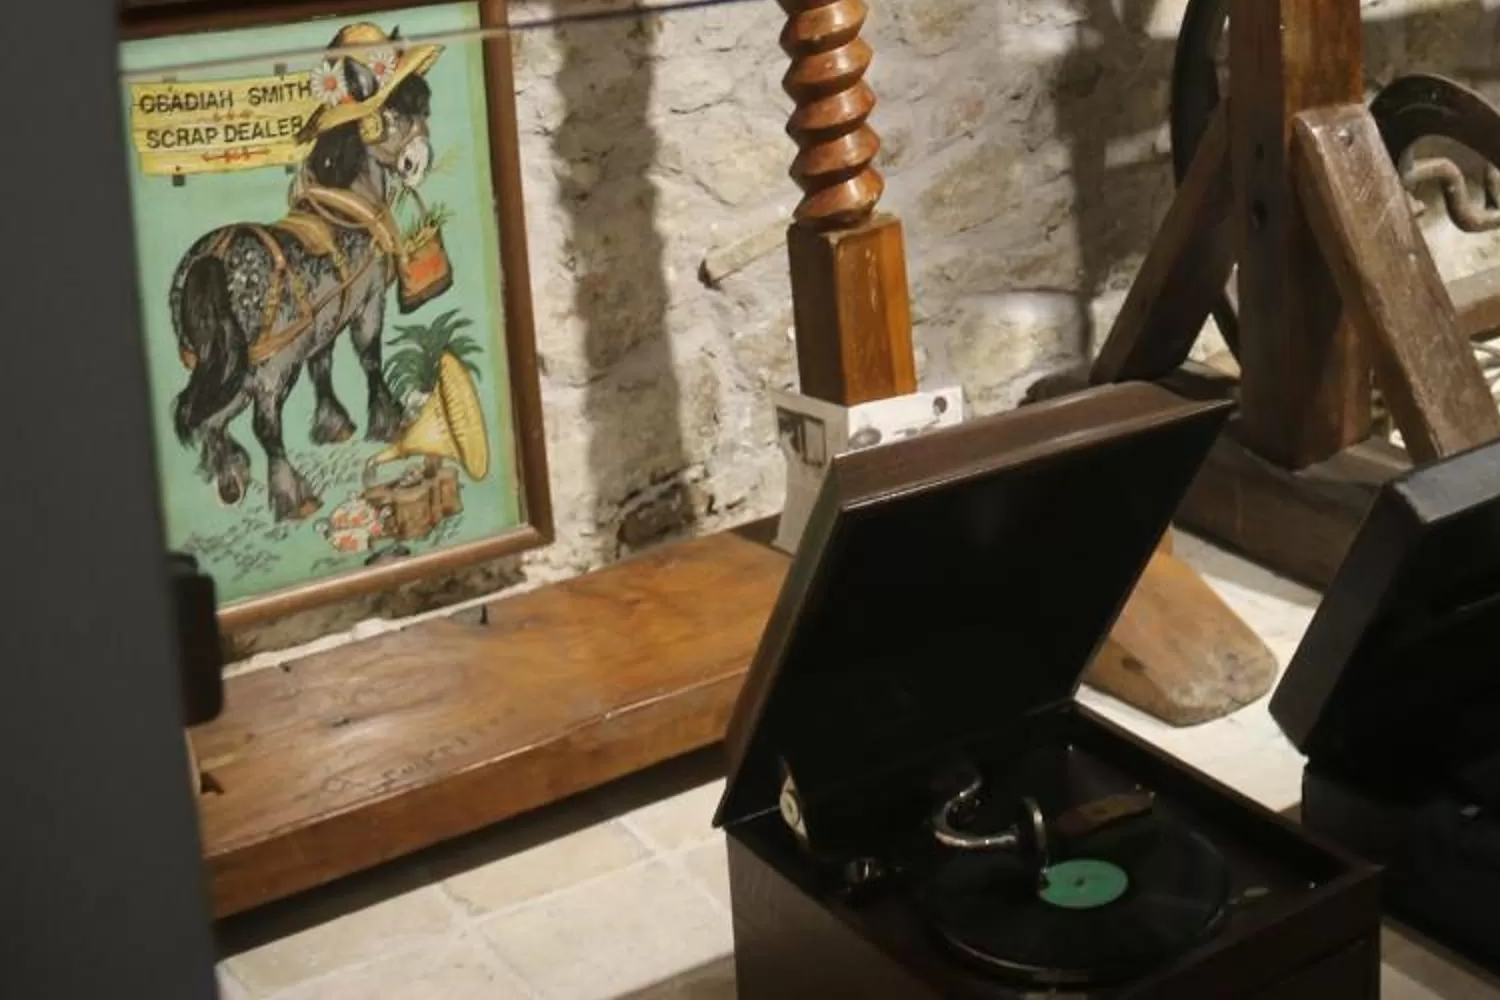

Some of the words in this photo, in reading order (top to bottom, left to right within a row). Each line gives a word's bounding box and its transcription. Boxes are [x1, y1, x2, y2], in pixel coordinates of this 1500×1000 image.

[139, 91, 233, 114] OBADIAH
[247, 79, 313, 106] SMITH
[146, 125, 218, 149] SCRAP
[223, 115, 304, 144] DEALER
